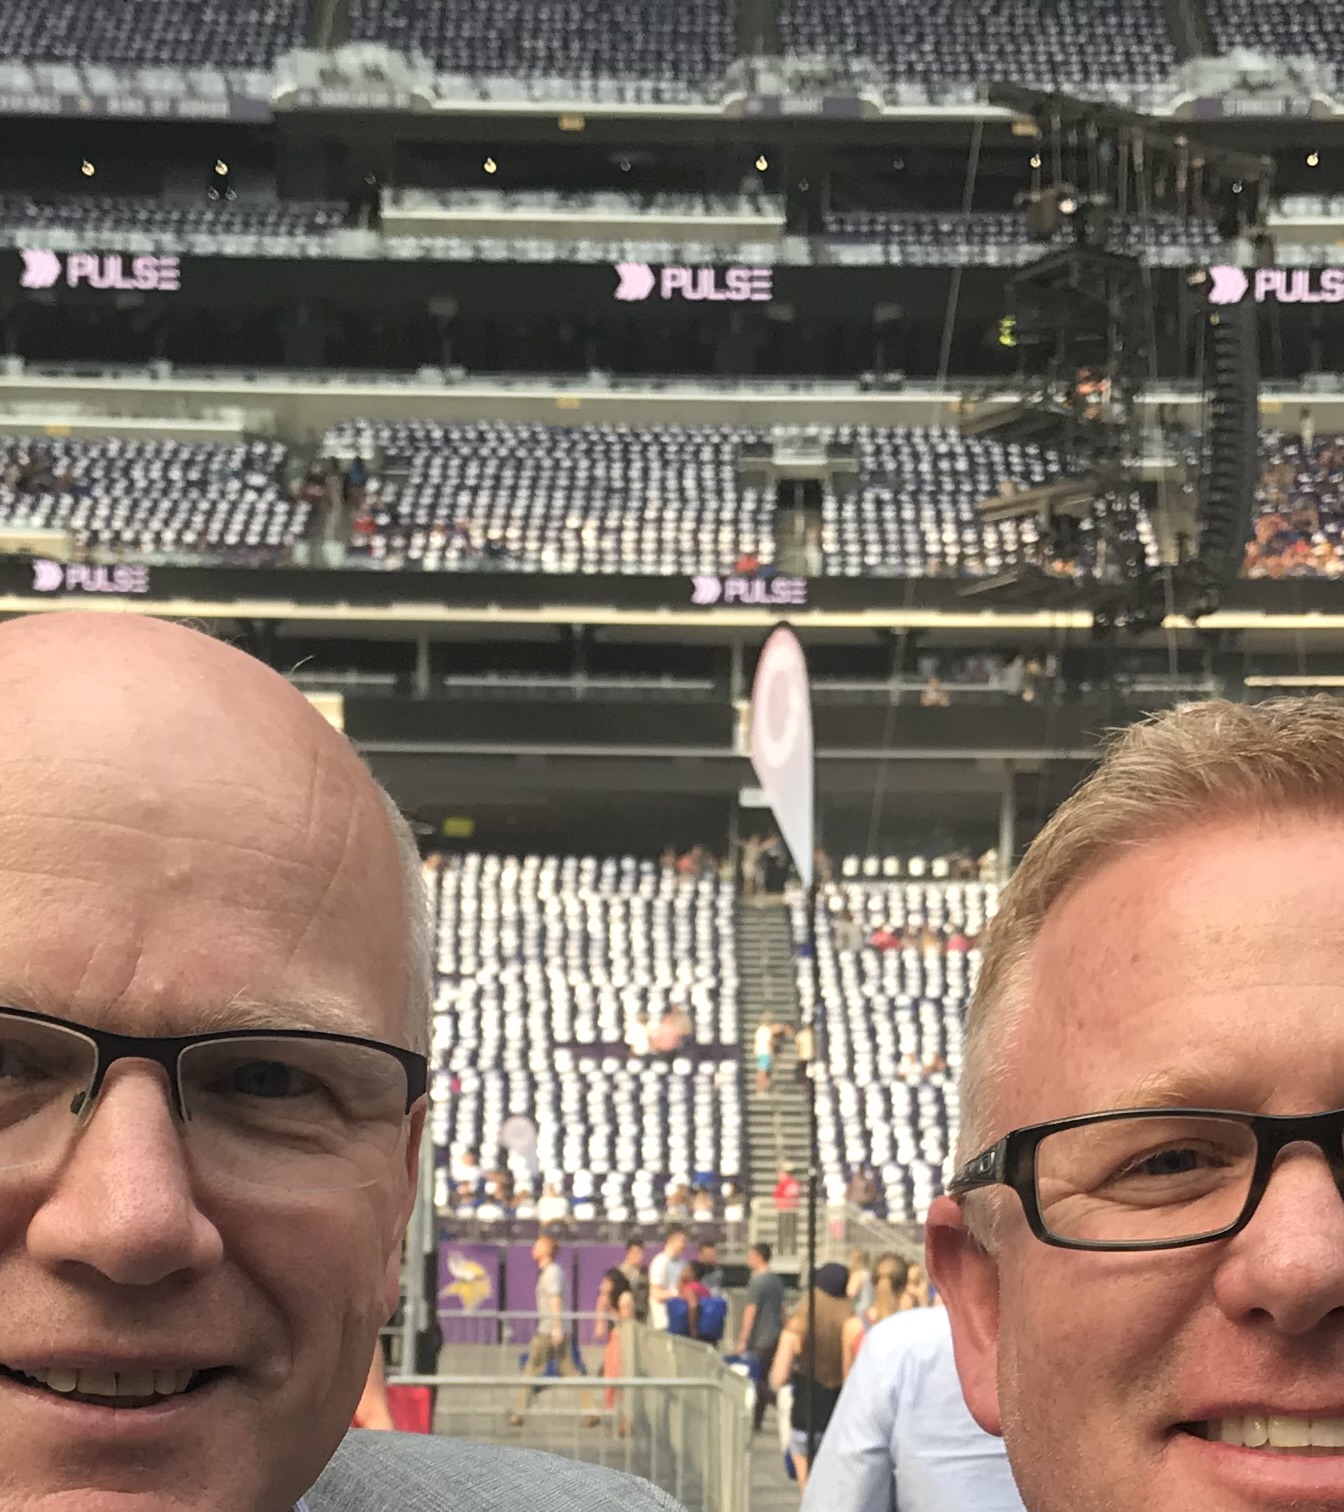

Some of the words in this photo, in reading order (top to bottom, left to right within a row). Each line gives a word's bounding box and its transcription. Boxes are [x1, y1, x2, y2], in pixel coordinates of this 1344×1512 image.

[67, 253, 180, 290] PULSE
[661, 266, 772, 301] PULSE
[65, 564, 150, 593] PULSE
[726, 577, 807, 604] PULSE
